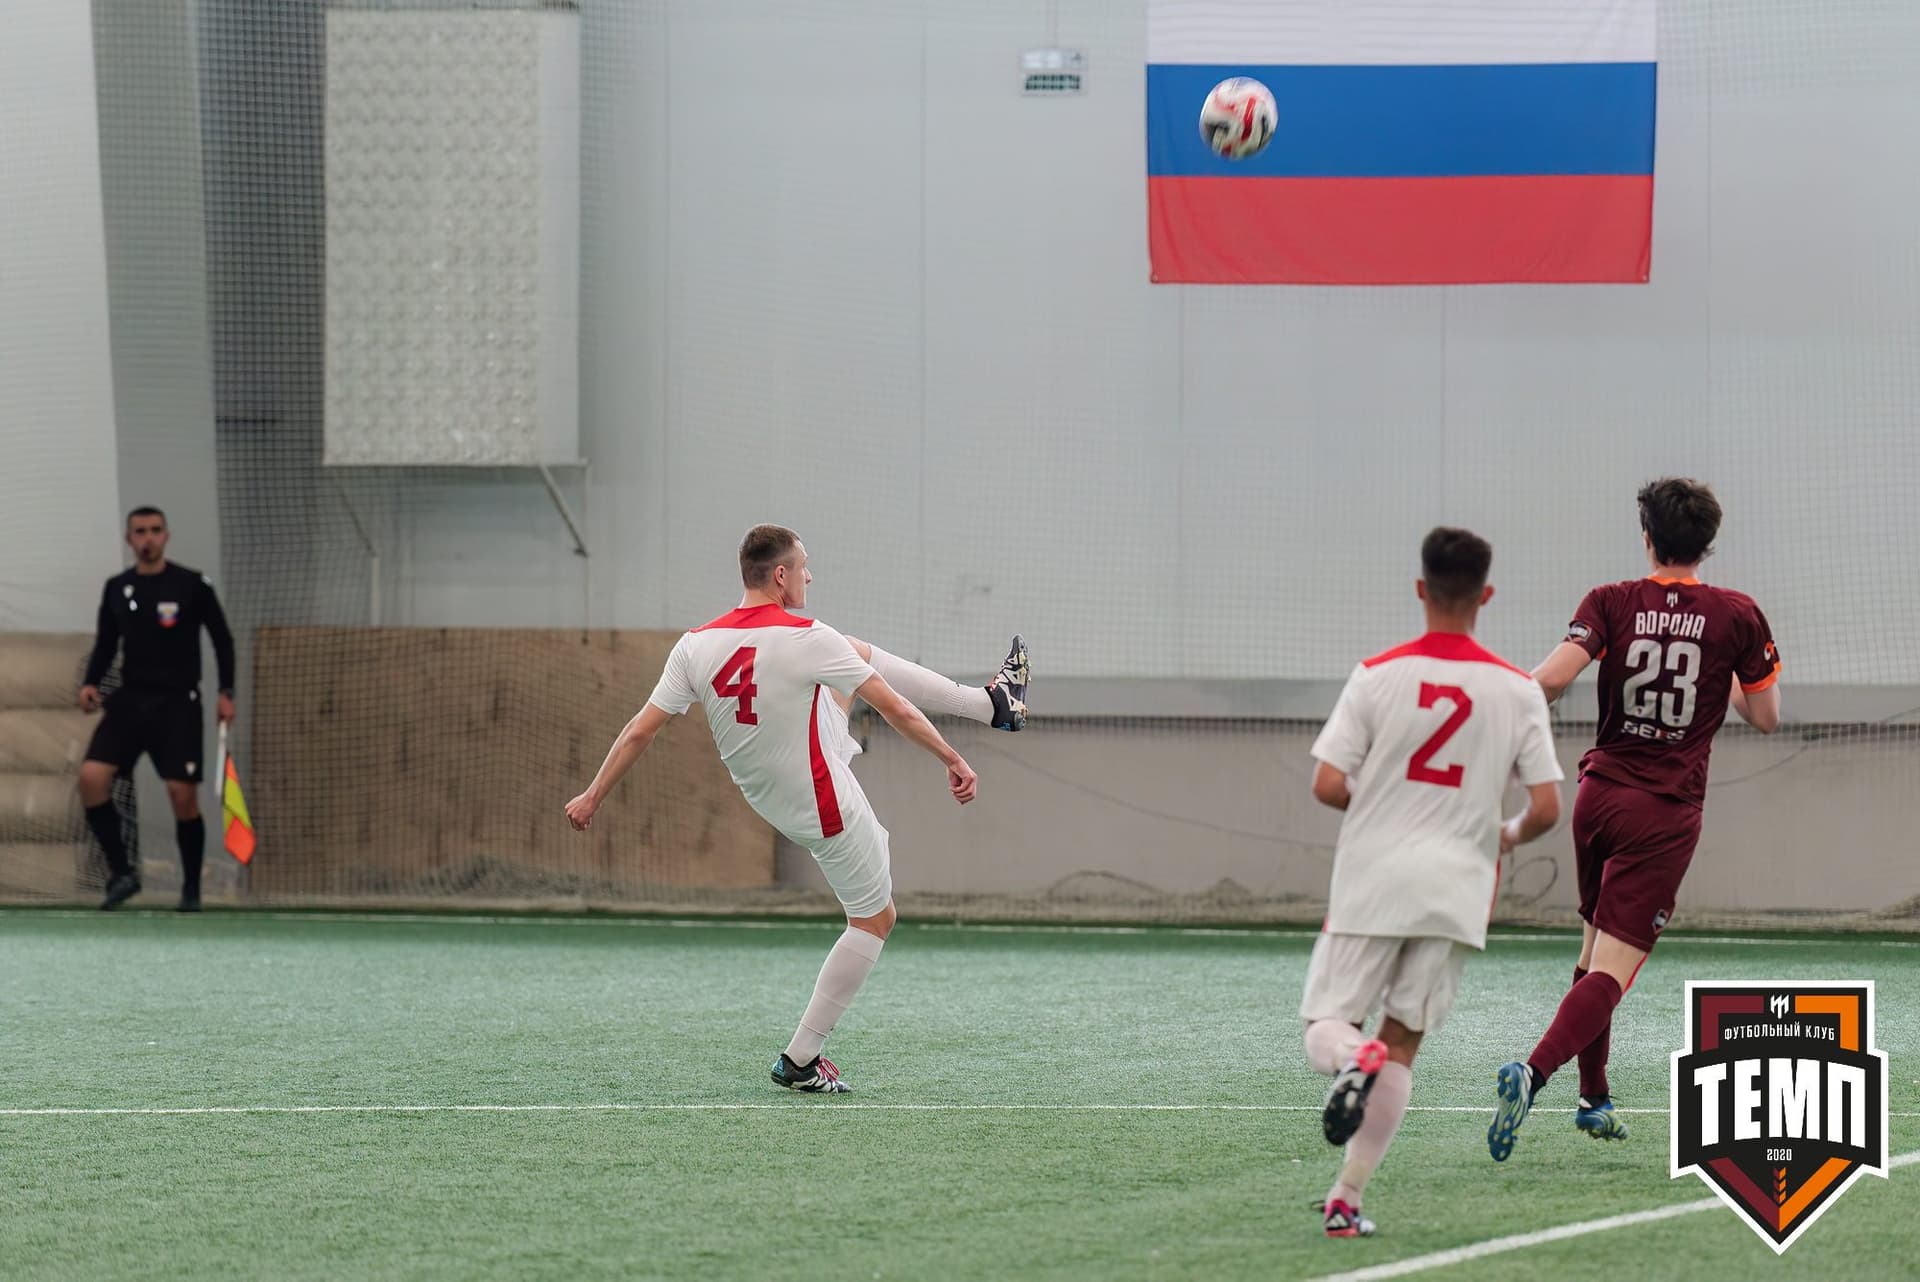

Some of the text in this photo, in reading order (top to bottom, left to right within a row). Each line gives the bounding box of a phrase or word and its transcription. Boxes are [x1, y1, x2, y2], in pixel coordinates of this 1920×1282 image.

[1635, 611, 1706, 639] ВОРОНА
[711, 646, 758, 726] 4
[1623, 639, 1701, 728] 23
[1406, 681, 1473, 788] 2
